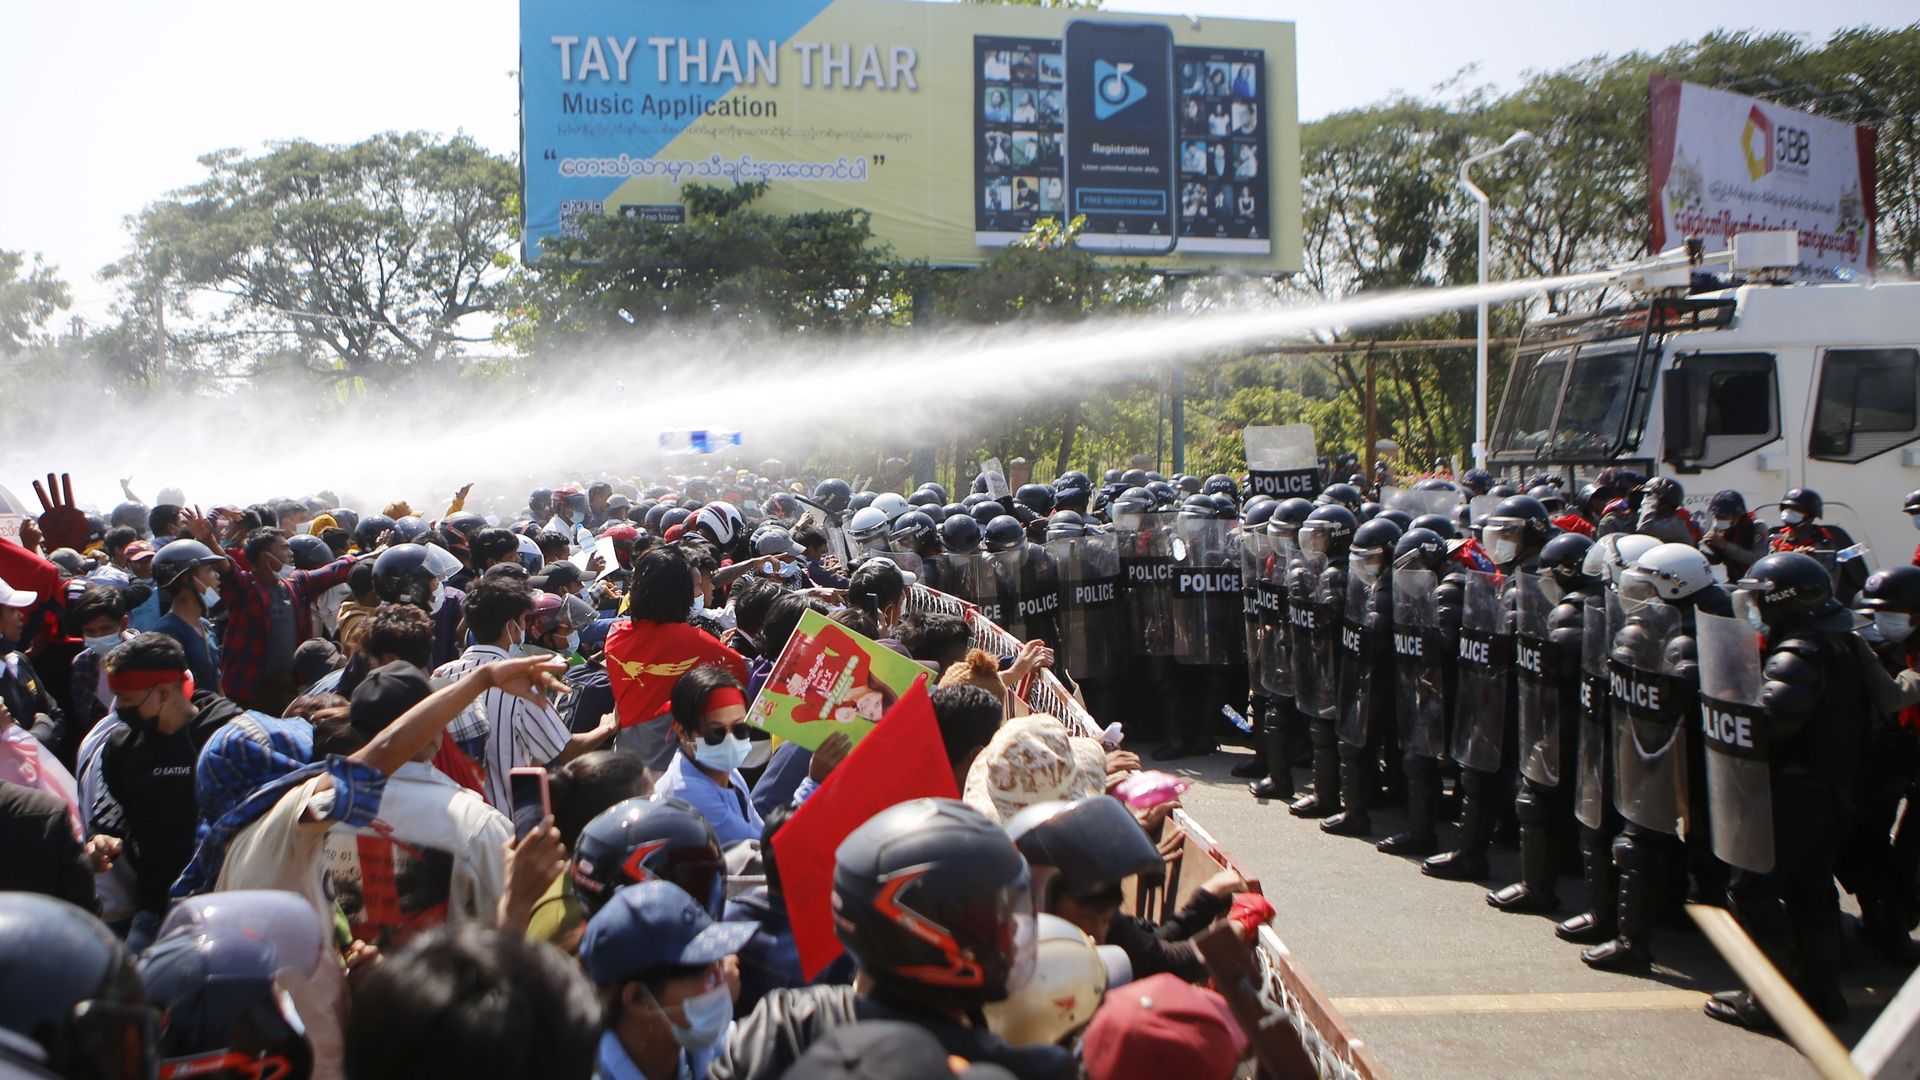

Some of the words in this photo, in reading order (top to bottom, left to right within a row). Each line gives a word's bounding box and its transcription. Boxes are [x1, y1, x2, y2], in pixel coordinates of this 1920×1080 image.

[551, 35, 637, 81] TAY
[648, 37, 778, 85] THAN
[793, 42, 918, 90] THAR
[562, 92, 633, 115] Music
[641, 94, 777, 119] Application
[1092, 143, 1150, 155] Registration
[1776, 126, 1809, 165] 5BB
[1210, 480, 1231, 488] POLICE
[1254, 474, 1313, 494] POLICE
[1128, 564, 1175, 580] POLICE
[1180, 574, 1240, 593] POLICE
[1018, 592, 1059, 617] POLICE
[1075, 583, 1114, 603] POLICE
[1257, 588, 1279, 610] LICE
[1764, 587, 1797, 603] POLICE
[1289, 605, 1315, 629] OLICE
[1343, 626, 1360, 653] LICE
[1394, 632, 1423, 656] OLICE
[1460, 637, 1490, 663] OLICE
[1517, 642, 1541, 673] LICE
[1610, 671, 1661, 711] POLICE
[1701, 702, 1754, 749] LICE
